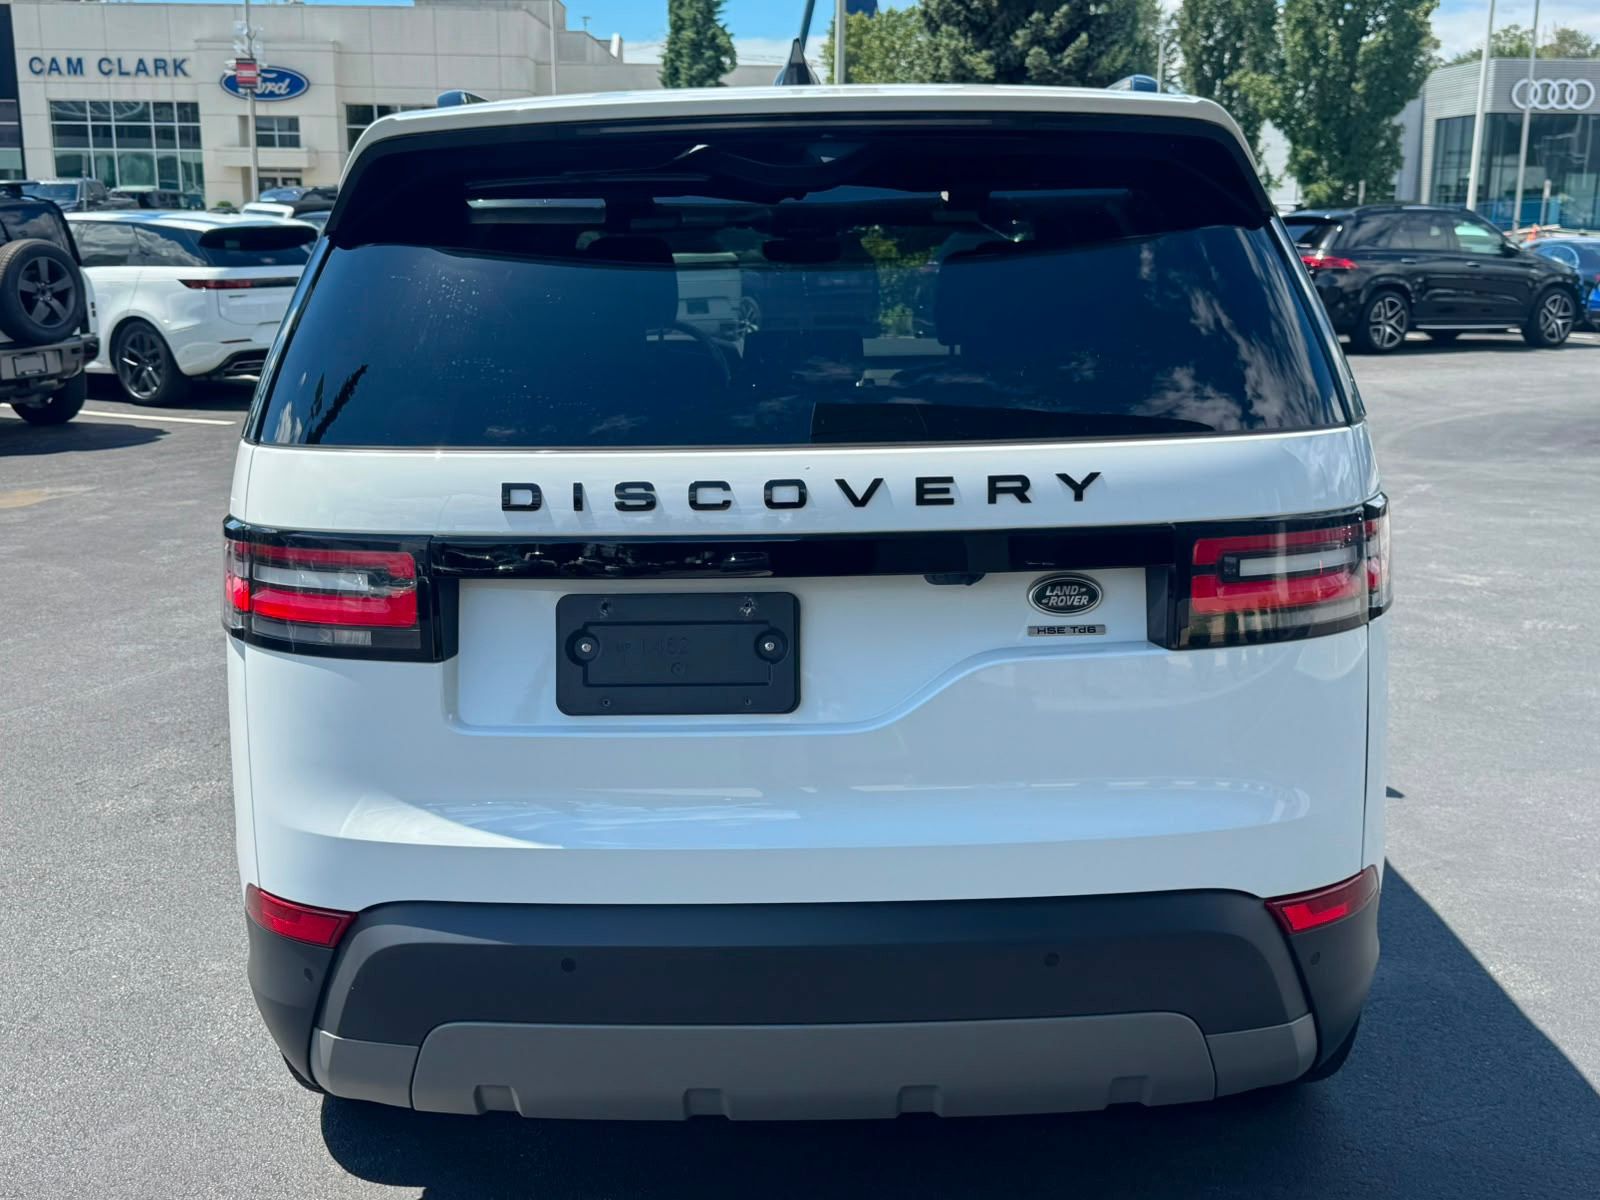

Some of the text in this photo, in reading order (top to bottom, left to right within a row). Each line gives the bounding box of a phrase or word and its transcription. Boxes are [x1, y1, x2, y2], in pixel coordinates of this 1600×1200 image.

[28, 56, 190, 78] CAM CLARK
[502, 472, 1101, 512] DISCOVERY
[1045, 585, 1079, 596] LAND
[1048, 595, 1089, 606] ROVER
[1037, 626, 1066, 635] HSE
